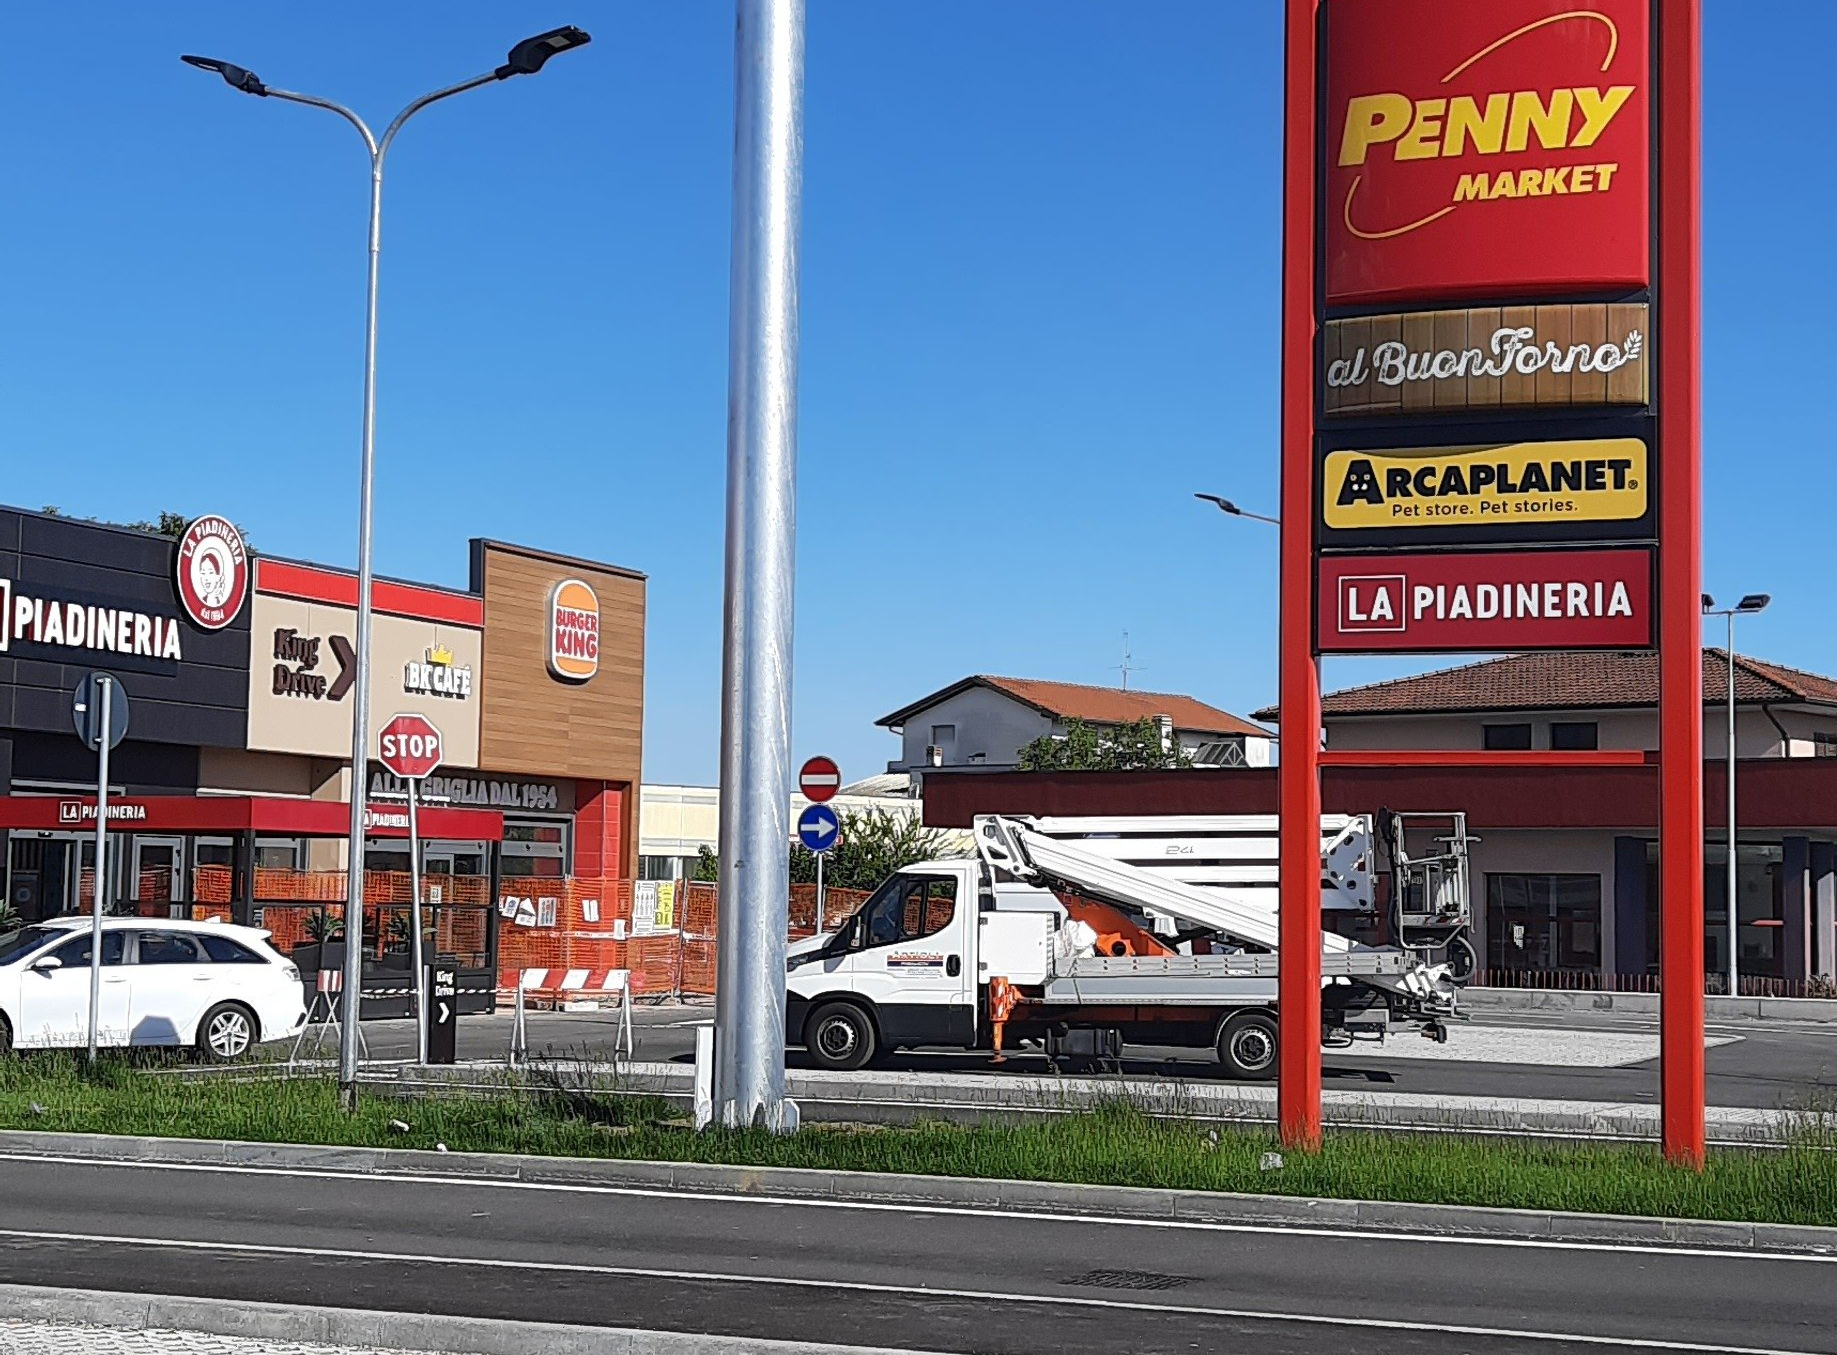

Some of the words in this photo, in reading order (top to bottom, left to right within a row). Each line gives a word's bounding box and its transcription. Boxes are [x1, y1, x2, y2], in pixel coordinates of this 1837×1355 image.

[1337, 85, 1636, 167] PENNY
[1453, 163, 1618, 202] MARKET
[1327, 348, 1369, 387] al
[1392, 504, 1420, 517] Pet
[1426, 503, 1473, 516] store.
[1480, 500, 1508, 514] Pet
[1514, 498, 1578, 513] stories.
[183, 538, 196, 558] LA
[195, 520, 243, 565] PIADINERIA
[556, 607, 597, 632] BURGER
[1348, 587, 1394, 621] LA
[1414, 581, 1633, 620] PIADINERIA
[14, 595, 182, 660] PIADINERIA
[556, 628, 597, 658] KING
[273, 629, 321, 670] King
[273, 664, 327, 700] Drive
[405, 662, 433, 692] BK
[382, 734, 438, 758] STOP
[371, 772, 415, 794] ALL
[420, 777, 488, 804] GRIGLIA
[489, 780, 521, 807] DAL
[522, 784, 557, 809] 1954
[63, 805, 77, 818] LA
